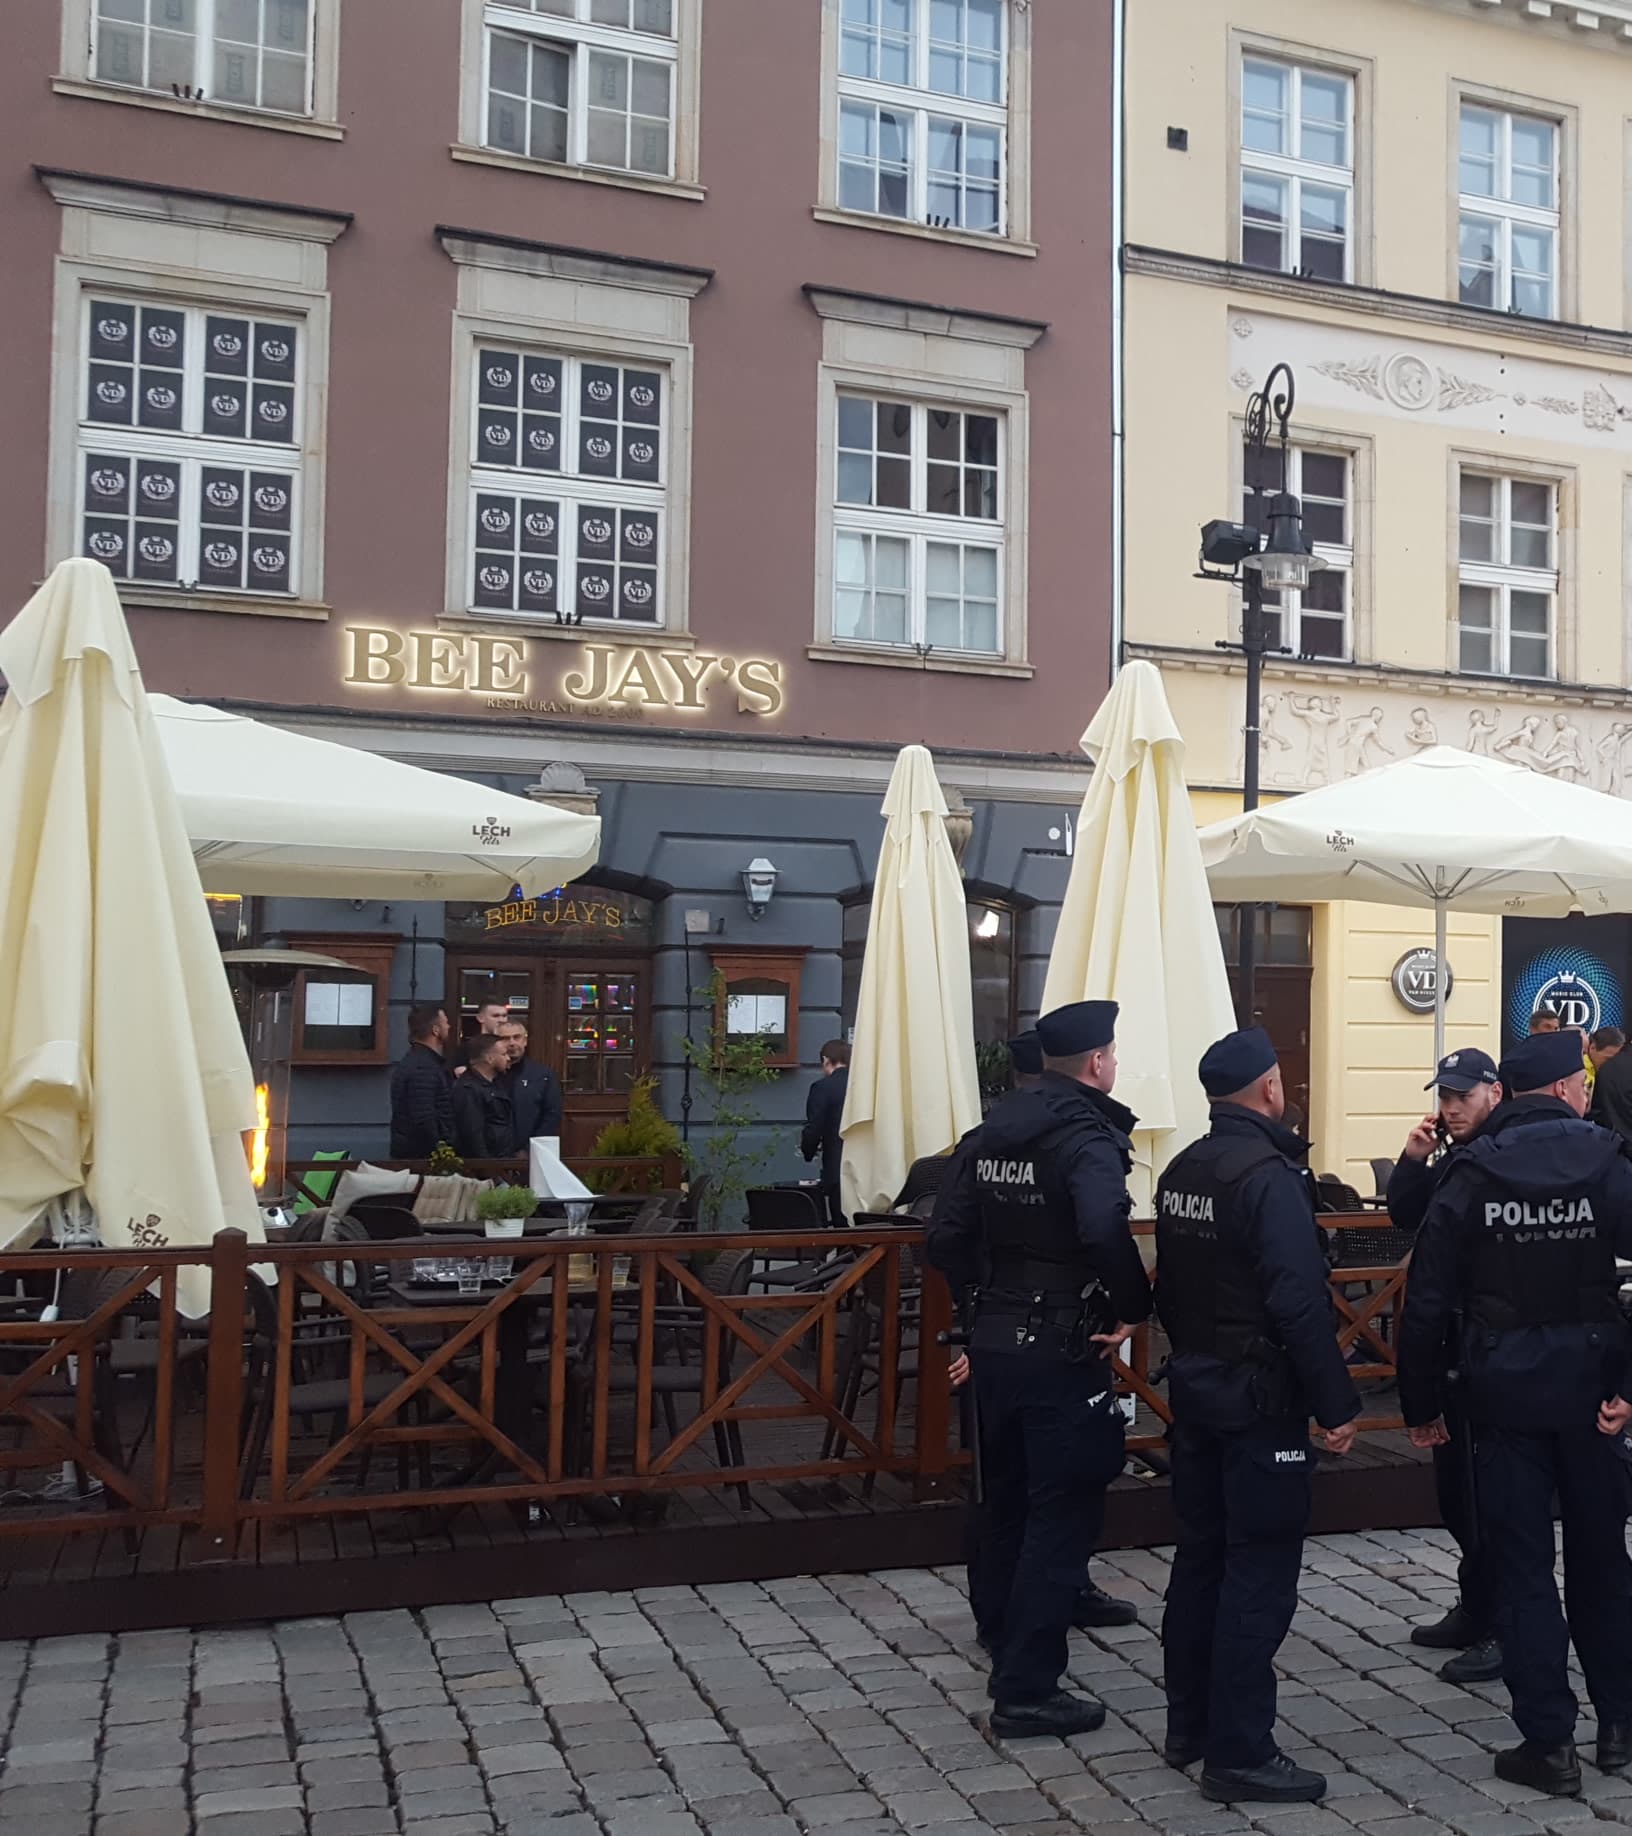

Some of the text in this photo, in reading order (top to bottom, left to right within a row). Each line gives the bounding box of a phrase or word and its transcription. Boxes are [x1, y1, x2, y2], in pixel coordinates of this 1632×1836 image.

[104, 325, 120, 336] VD
[154, 331, 171, 342] VD
[219, 340, 236, 350] VD
[267, 347, 282, 356] VD
[492, 372, 507, 382] VD
[535, 378, 550, 388] VD
[103, 388, 118, 398] VD
[593, 386, 607, 395] VD
[153, 393, 169, 404] VD
[635, 392, 649, 401] VD
[218, 401, 234, 412] VD
[265, 407, 281, 417] VD
[491, 430, 505, 440] VD
[534, 435, 549, 445] VD
[591, 442, 606, 452] VD
[634, 447, 648, 457] VD
[97, 476, 118, 489] VD
[149, 482, 168, 494] VD
[213, 488, 232, 500] VD
[261, 494, 280, 505] VD
[487, 514, 505, 526] VD
[531, 520, 548, 531] VD
[588, 526, 606, 537] VD
[630, 530, 647, 541] VD
[96, 539, 116, 551] VD
[147, 543, 166, 555] VD
[212, 550, 231, 562] VD
[259, 554, 278, 566] VD
[486, 573, 503, 585] VD
[530, 577, 547, 588] VD
[587, 583, 604, 594] VD
[629, 587, 646, 598] VD
[345, 626, 782, 715] BEE JAY'S
[487, 697, 575, 713] RESTAURANT
[472, 825, 511, 837] LECH
[1326, 835, 1354, 846] LECH
[484, 898, 621, 930] BEE JAY'S
[1544, 1000, 1590, 1025] VD
[977, 1159, 1035, 1185] POLICJA
[1162, 1190, 1215, 1222] POLICJA
[1485, 1197, 1594, 1226] POLICJA
[127, 1217, 168, 1246] LECH
[1275, 1450, 1306, 1462] POLICJA
